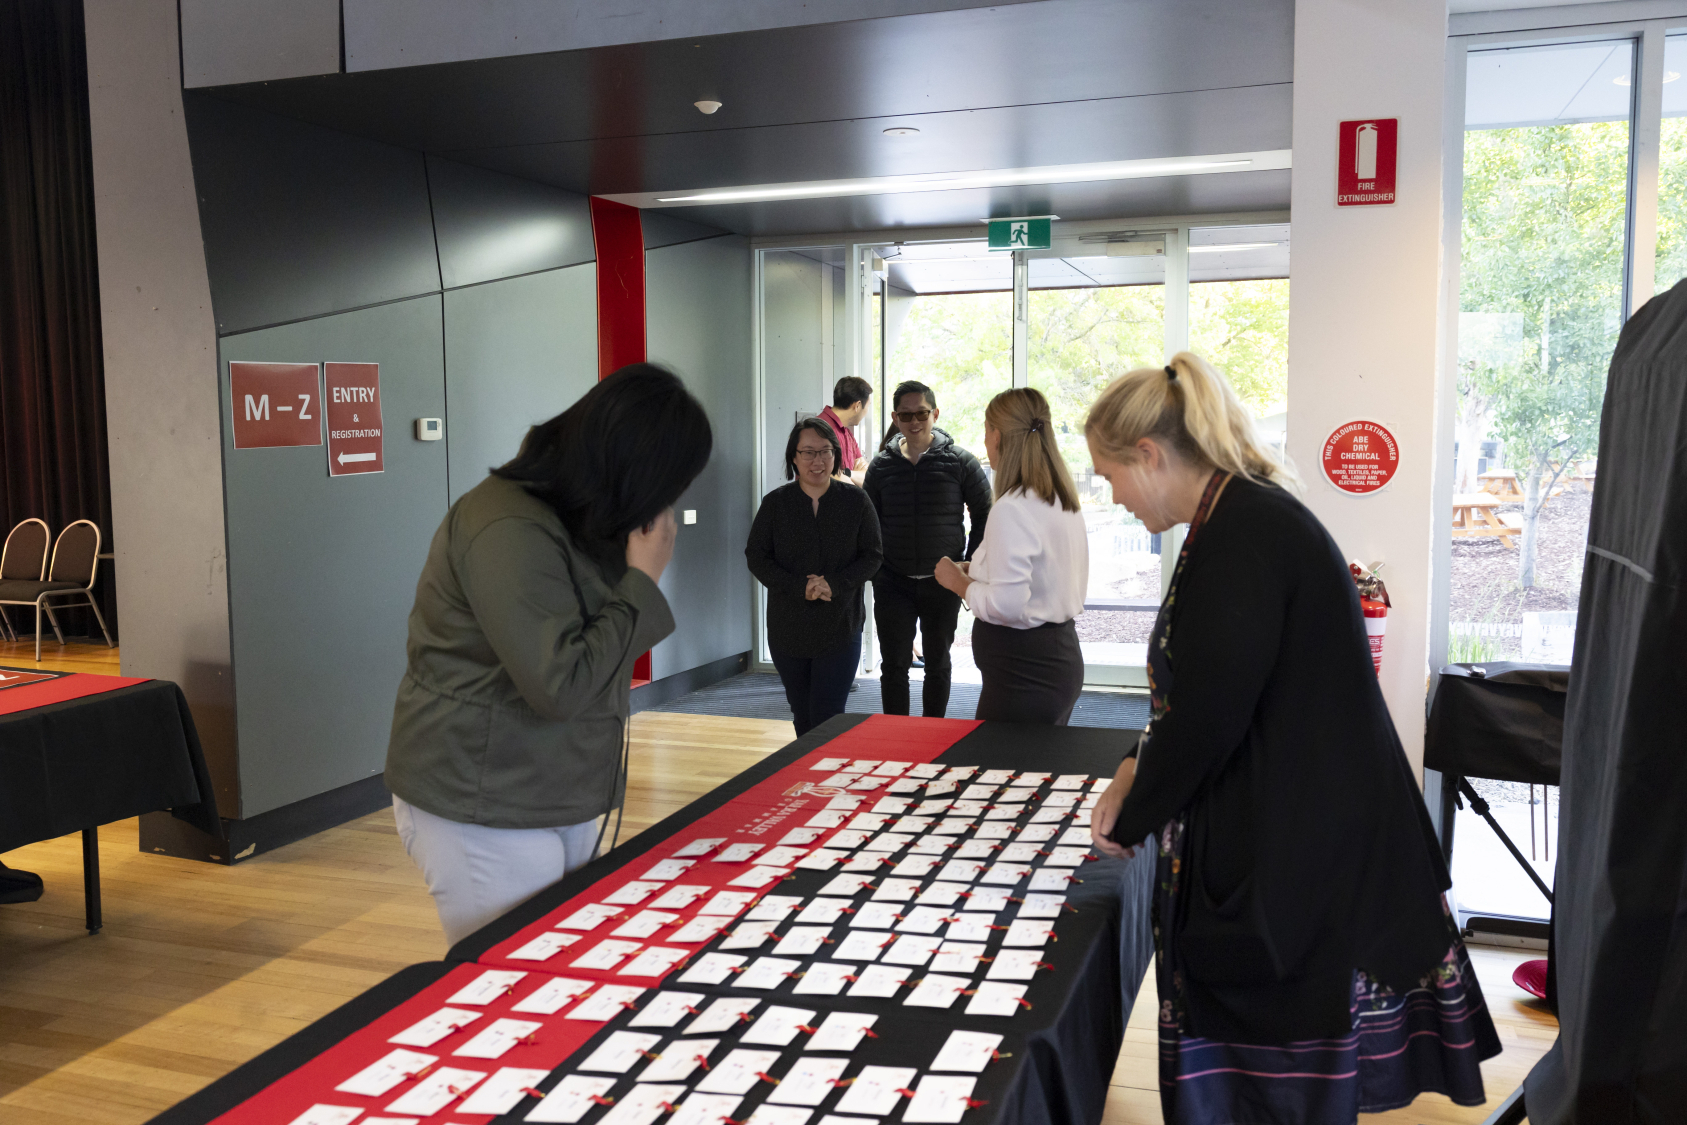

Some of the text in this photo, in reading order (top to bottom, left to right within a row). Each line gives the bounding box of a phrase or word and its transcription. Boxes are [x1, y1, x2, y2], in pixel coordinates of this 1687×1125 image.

[1357, 182, 1375, 190] FIRE
[1338, 192, 1394, 203] EXTINGUISHER
[332, 386, 376, 403] ENTRY
[244, 394, 270, 421] M
[298, 394, 312, 420] Z
[352, 413, 360, 423] &
[331, 428, 381, 440] REGISTRATION
[1325, 423, 1397, 461] THIS COLOURED EXTINGUISHER
[1340, 452, 1380, 460] CHEMICAL
[747, 815, 787, 836] VALLEY
